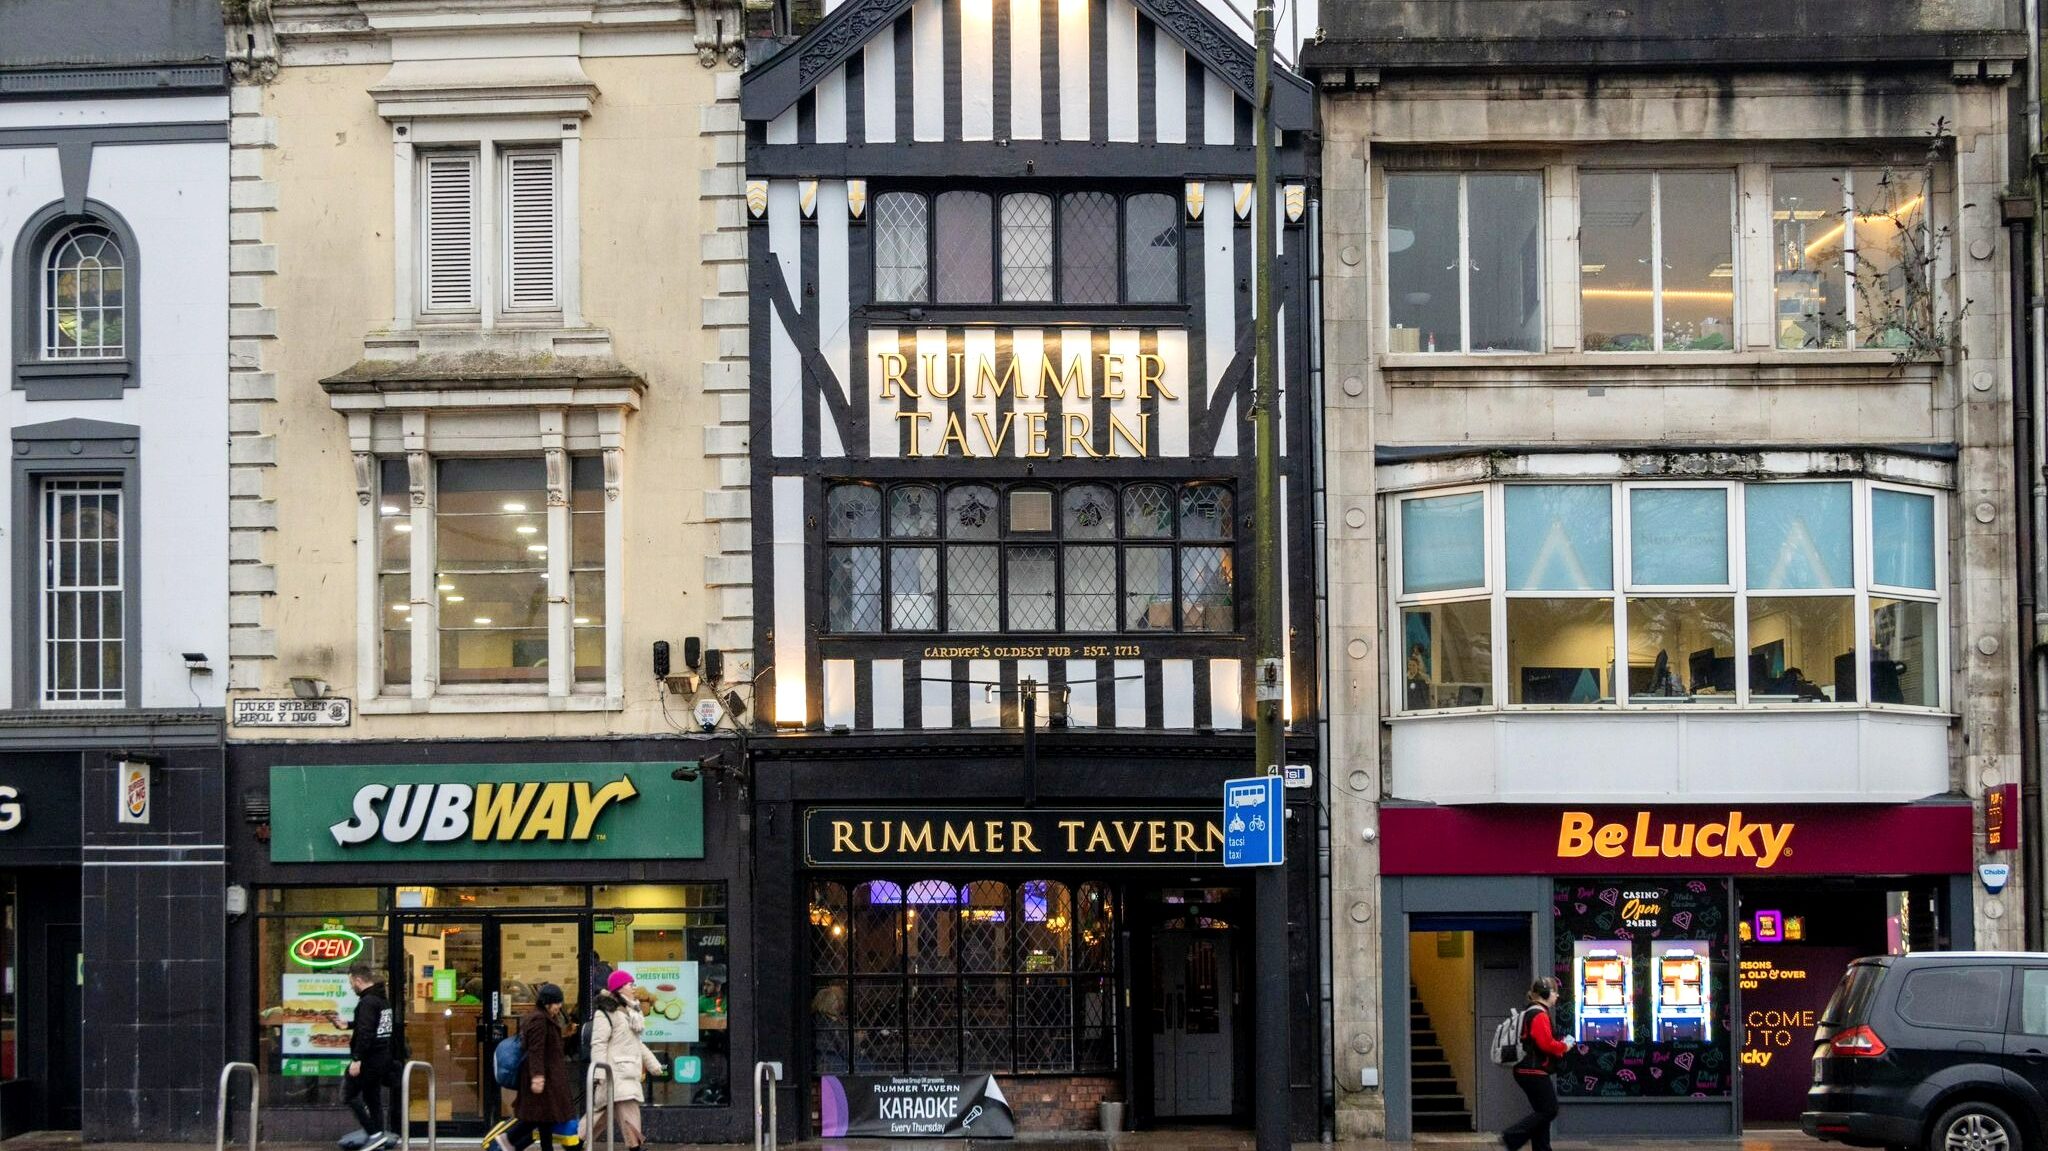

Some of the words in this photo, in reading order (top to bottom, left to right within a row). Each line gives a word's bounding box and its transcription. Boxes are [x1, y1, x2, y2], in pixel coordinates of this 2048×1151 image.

[878, 352, 1179, 400] RUMMER
[895, 411, 1151, 458] TAVERN
[924, 645, 991, 658] CARDIFF'S
[994, 647, 1044, 657] OLDEST
[1047, 647, 1071, 657] PUB
[1083, 646, 1111, 657] EST.
[1114, 645, 1140, 656] 1713
[239, 702, 275, 712] DUKE
[279, 701, 327, 711] STREET
[239, 713, 274, 723] HEOL
[277, 712, 286, 722] Y
[1269, 766, 1278, 776] 4
[330, 773, 639, 847] SUBWAY
[831, 820, 1042, 853] RUMMER
[1229, 836, 1246, 847] tacsi
[1557, 811, 1795, 869] BeLucky
[1229, 849, 1242, 860] taxi
[1984, 868, 2006, 876] Chubb
[1622, 891, 1660, 900] CASINO
[1621, 898, 1662, 921] Open
[1625, 919, 1657, 928] 24HRS
[299, 938, 353, 957] OPEN
[635, 972, 660, 980] CHEESY
[1747, 971, 1768, 979] OLD
[1745, 1011, 1814, 1027] COME
[1761, 1030, 1791, 1046] TO
[1740, 1049, 1772, 1067] cky
[879, 1097, 958, 1119] KARAOKE
[891, 1122, 912, 1133] Every
[912, 1121, 946, 1134] Thursday
